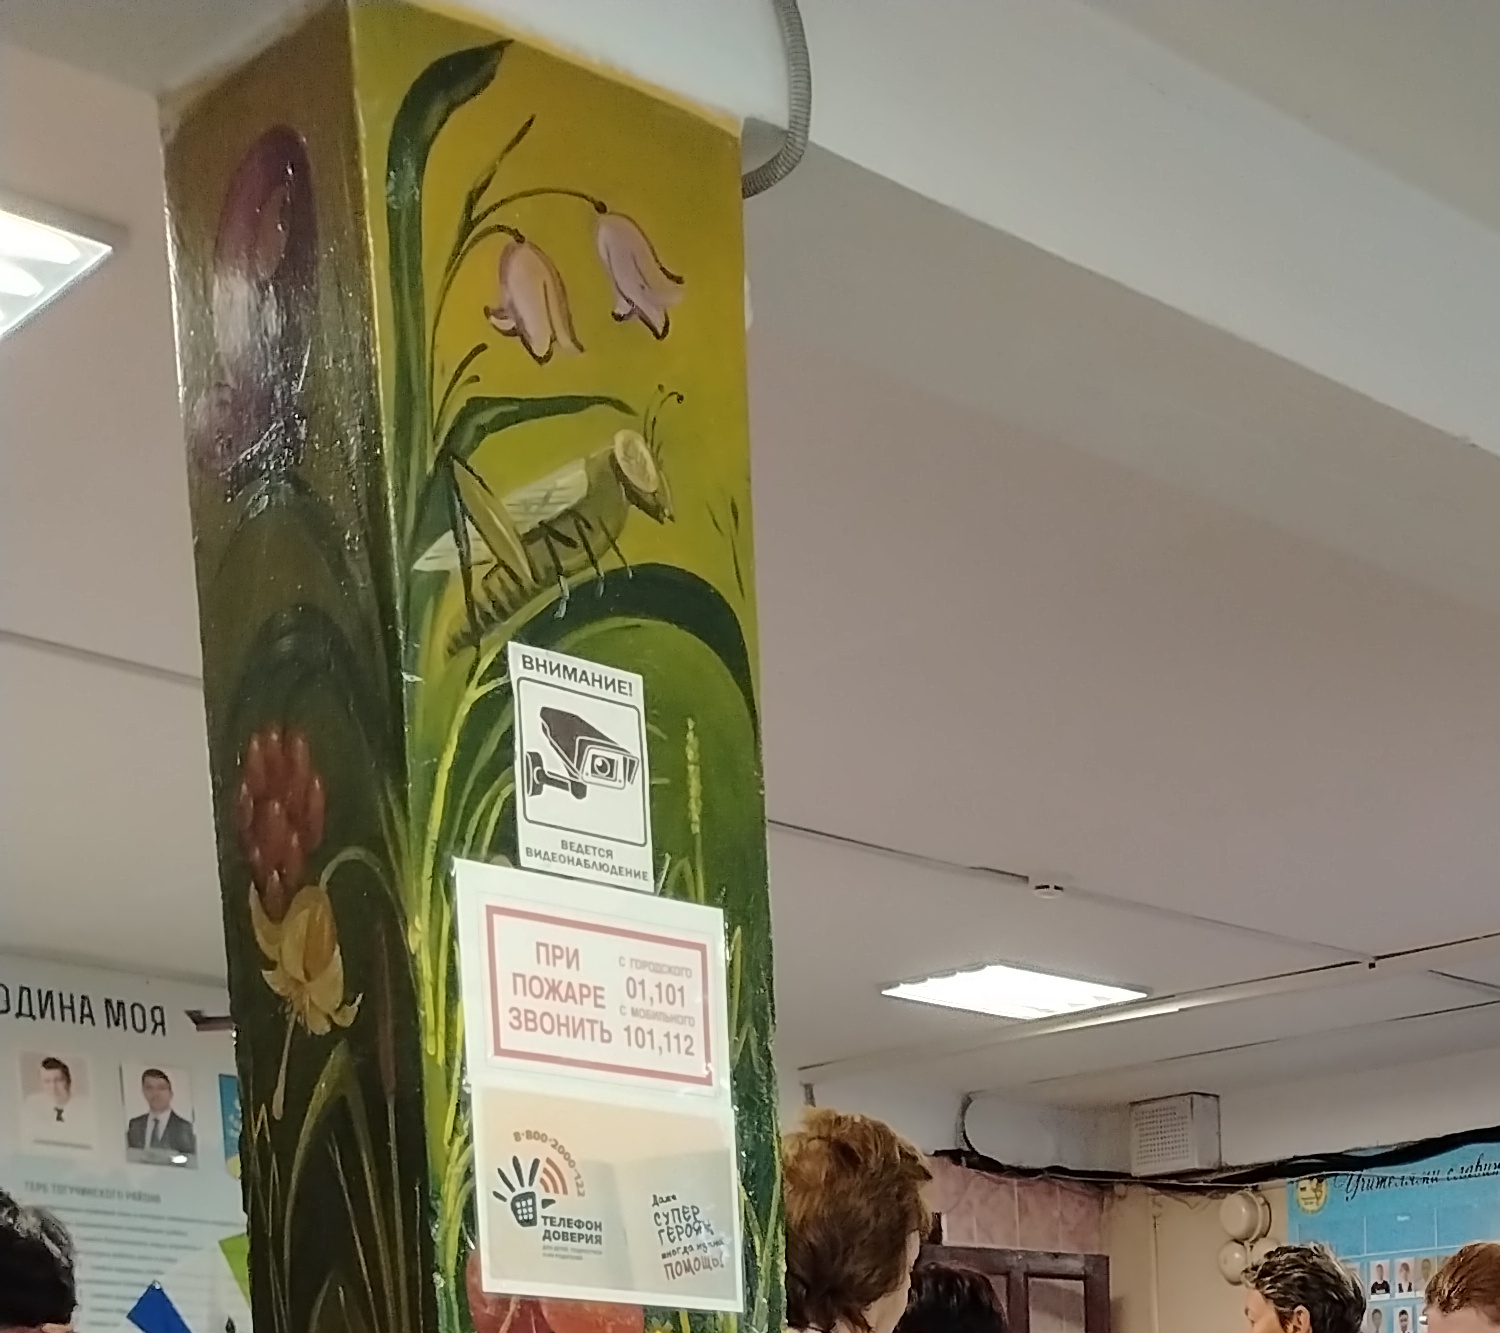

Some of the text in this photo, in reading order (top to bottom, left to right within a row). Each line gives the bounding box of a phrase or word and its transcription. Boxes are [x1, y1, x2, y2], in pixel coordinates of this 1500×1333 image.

[521, 654, 633, 697] ВНИМАНИЕ!
[525, 847, 649, 881] ВИДЕОНАБЛЮДЕНИЕ
[560, 839, 614, 860] ВЕДЕТСЯ
[536, 941, 580, 971] ПРИ
[630, 958, 692, 979] ГОРОДСКОГО
[512, 973, 606, 1009] ПОЖАРЕ
[626, 976, 686, 1007] 01,101
[104, 997, 166, 1037] МОЯ
[508, 1006, 613, 1044] ЗВОНИТЬ
[623, 1025, 695, 1056] 101,112
[541, 1215, 603, 1232] ТЕЛЕФОН
[654, 1204, 700, 1227] СУПЕР
[542, 1229, 603, 1245] ДОВЕРИЯ
[664, 1250, 724, 1281] ПОМОЩЬ!
